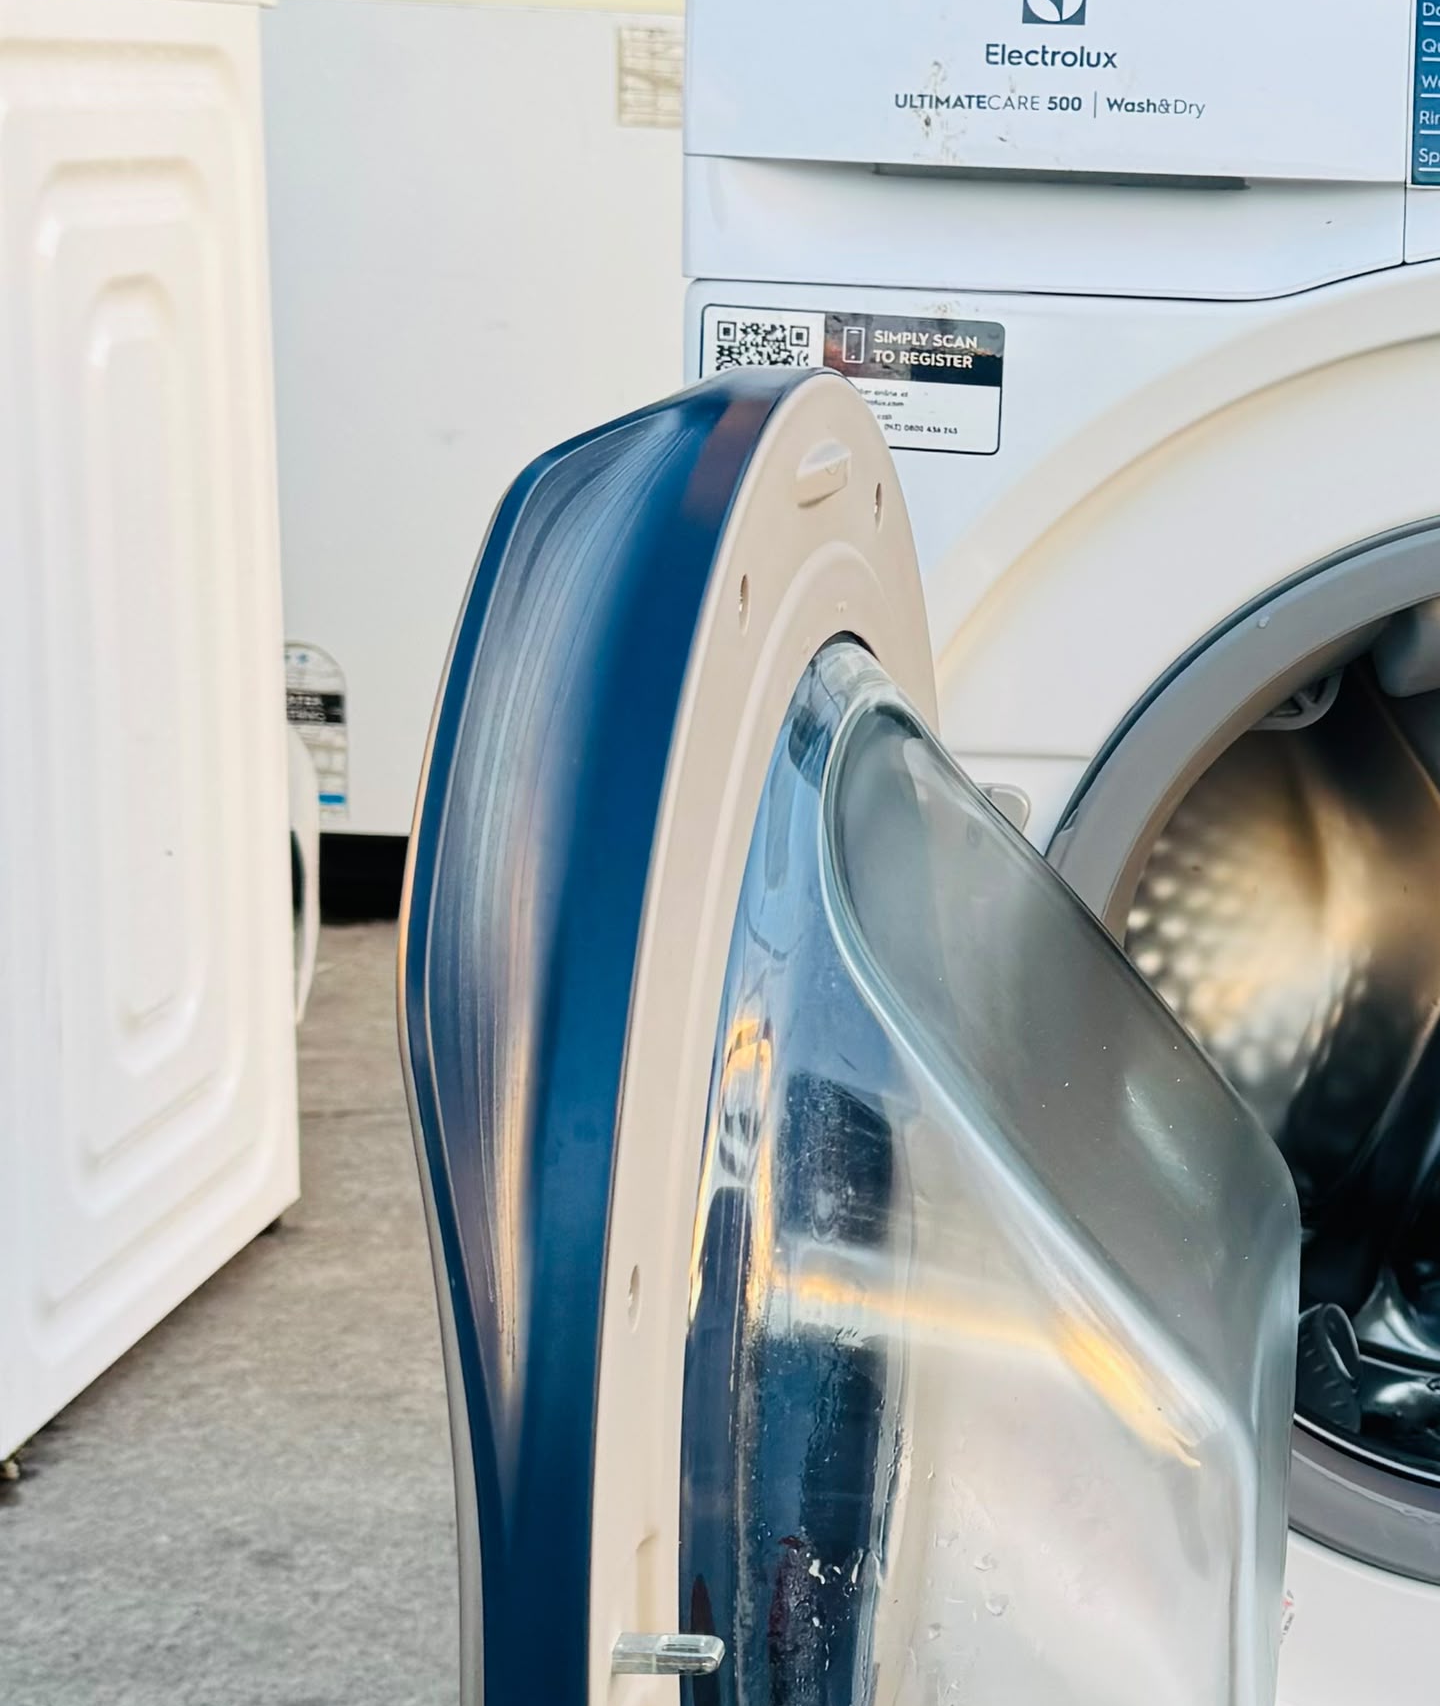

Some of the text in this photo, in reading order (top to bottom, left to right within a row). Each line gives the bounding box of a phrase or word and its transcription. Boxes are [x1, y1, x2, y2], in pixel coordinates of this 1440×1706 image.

[985, 43, 1117, 68] Electrolux
[894, 93, 1205, 118] ULTIMATECARE 500 Wash&Dry
[874, 330, 977, 349] SIMPLY SCAN
[874, 350, 973, 369] TO REGISTER
